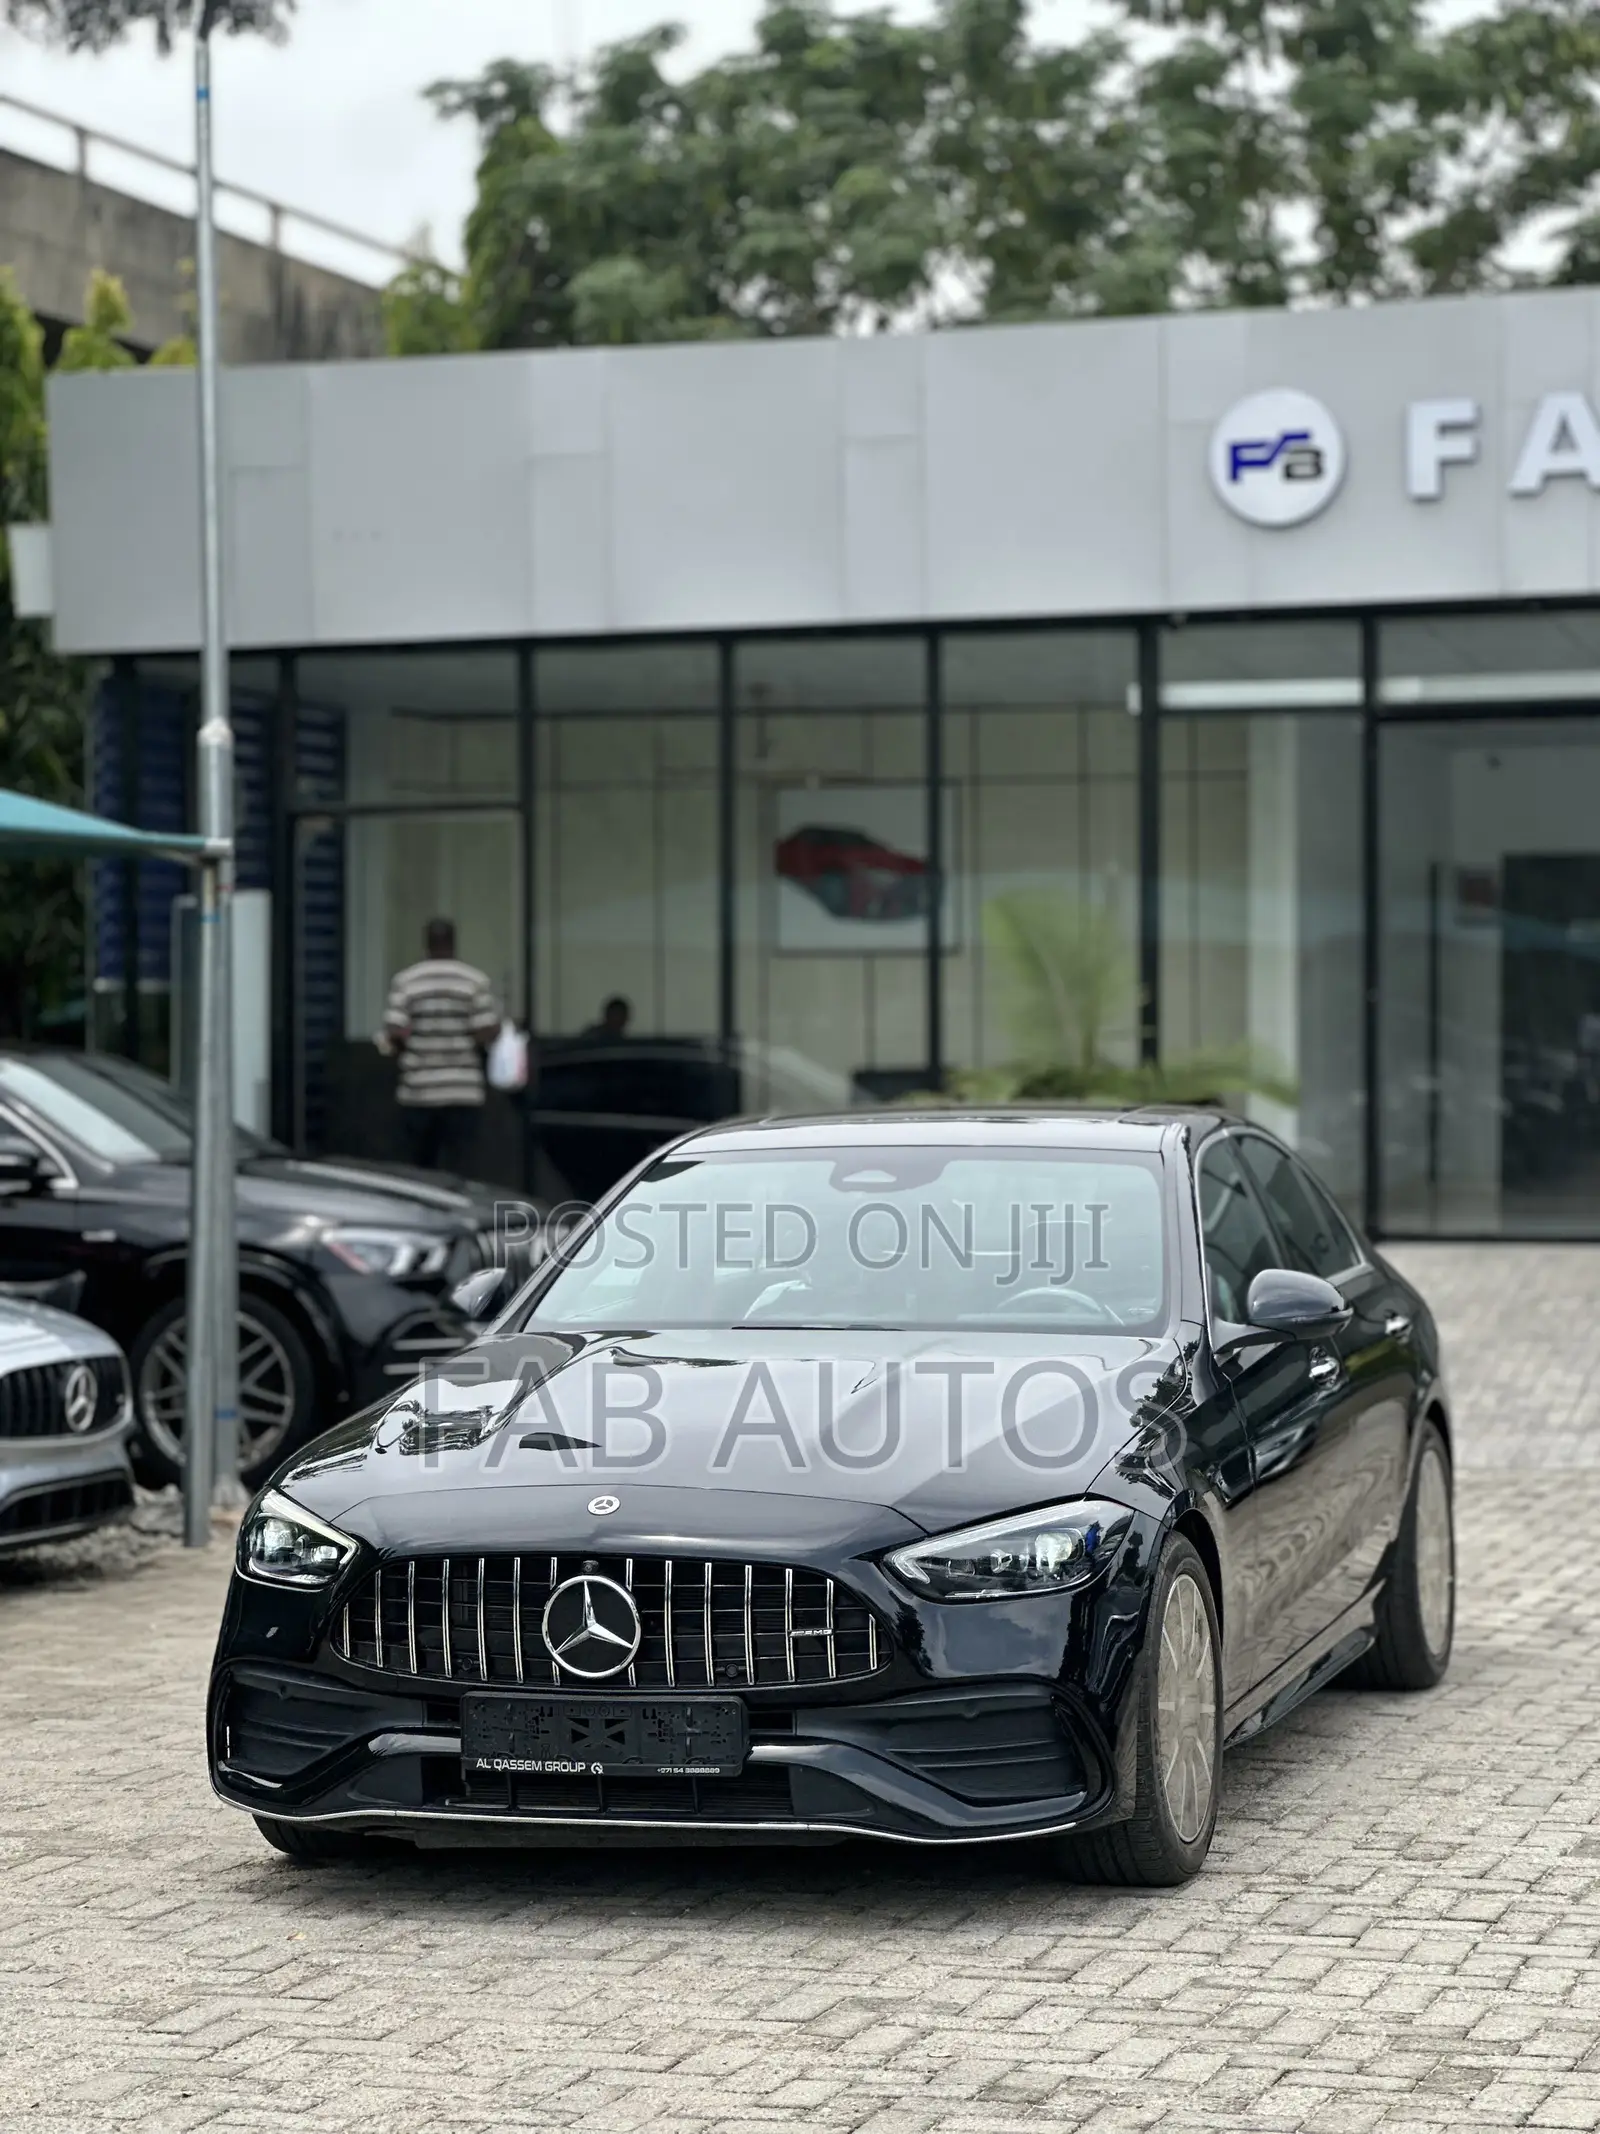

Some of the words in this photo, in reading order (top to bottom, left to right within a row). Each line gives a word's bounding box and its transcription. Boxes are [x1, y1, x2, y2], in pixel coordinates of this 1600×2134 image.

[476, 1758, 491, 1769] AL
[493, 1758, 542, 1771] QASSEM
[545, 1761, 586, 1773] GROUP
